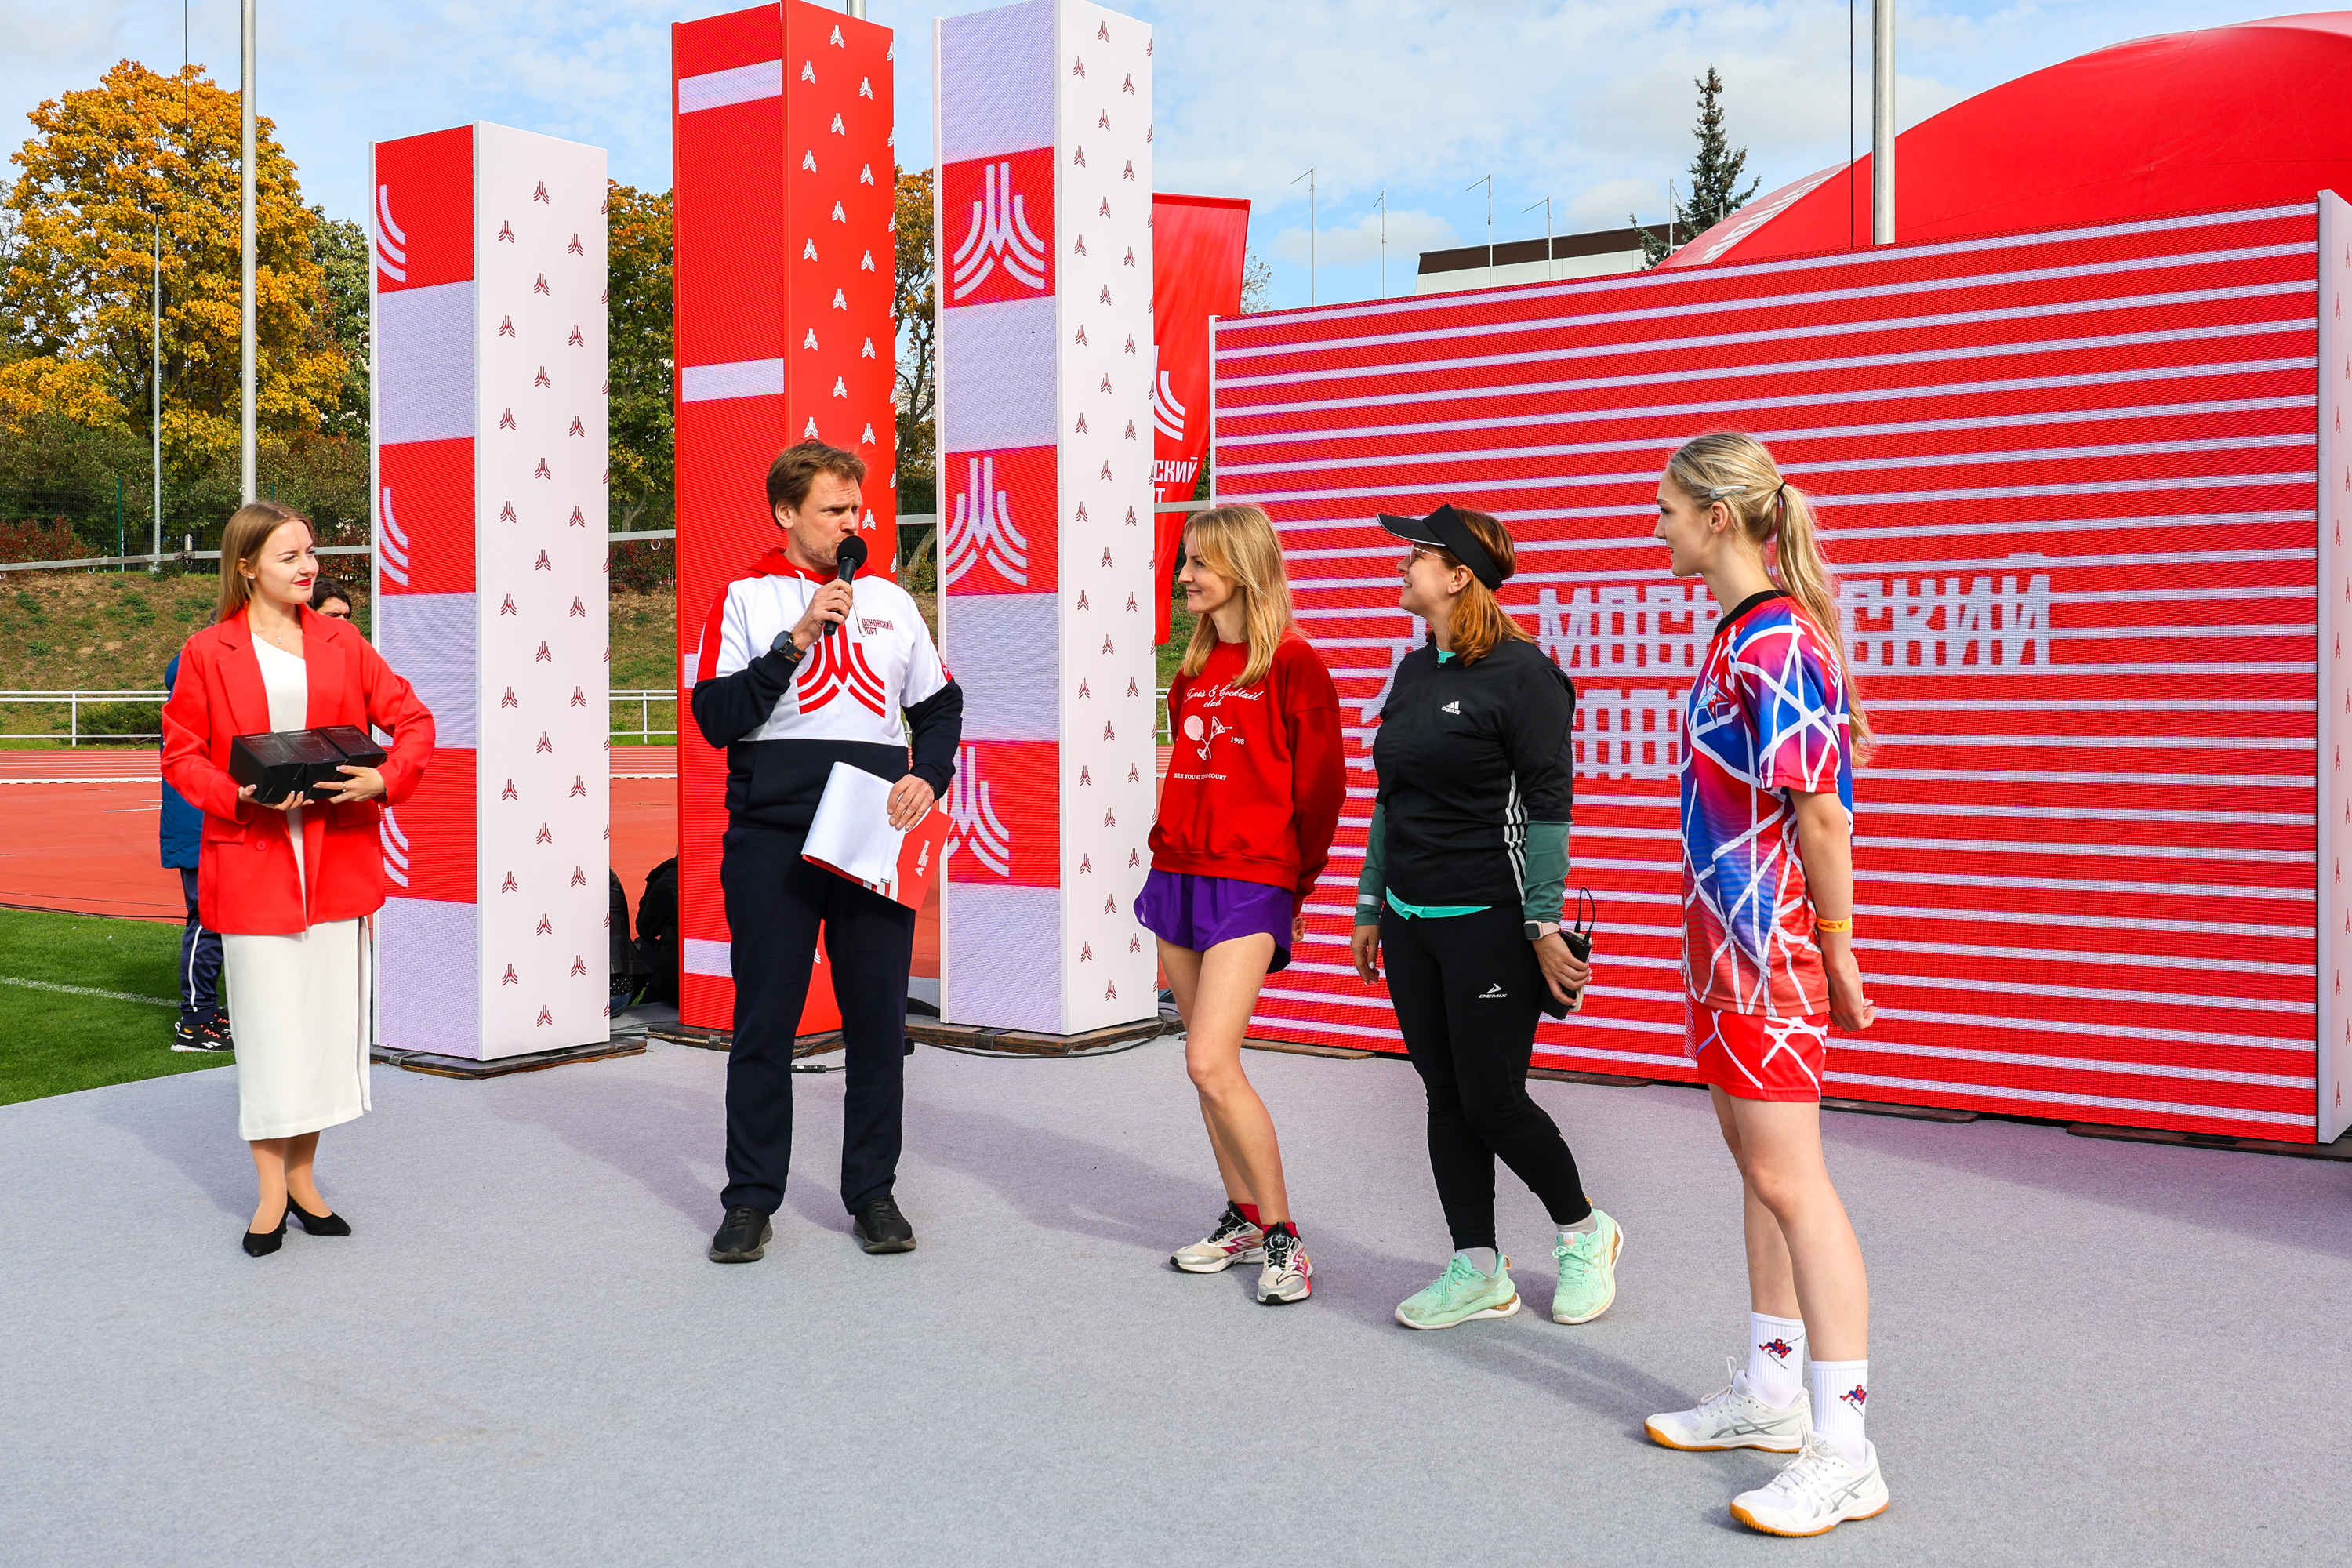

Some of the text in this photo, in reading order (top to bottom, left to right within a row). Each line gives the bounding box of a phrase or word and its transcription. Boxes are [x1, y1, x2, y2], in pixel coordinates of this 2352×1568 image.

[1153, 456, 1199, 483] СКИЙ
[861, 618, 894, 630] ОСКОВСКИЙ
[1219, 684, 1264, 701] Cocktail
[1203, 696, 1225, 708] club
[1230, 736, 1245, 745] 1998
